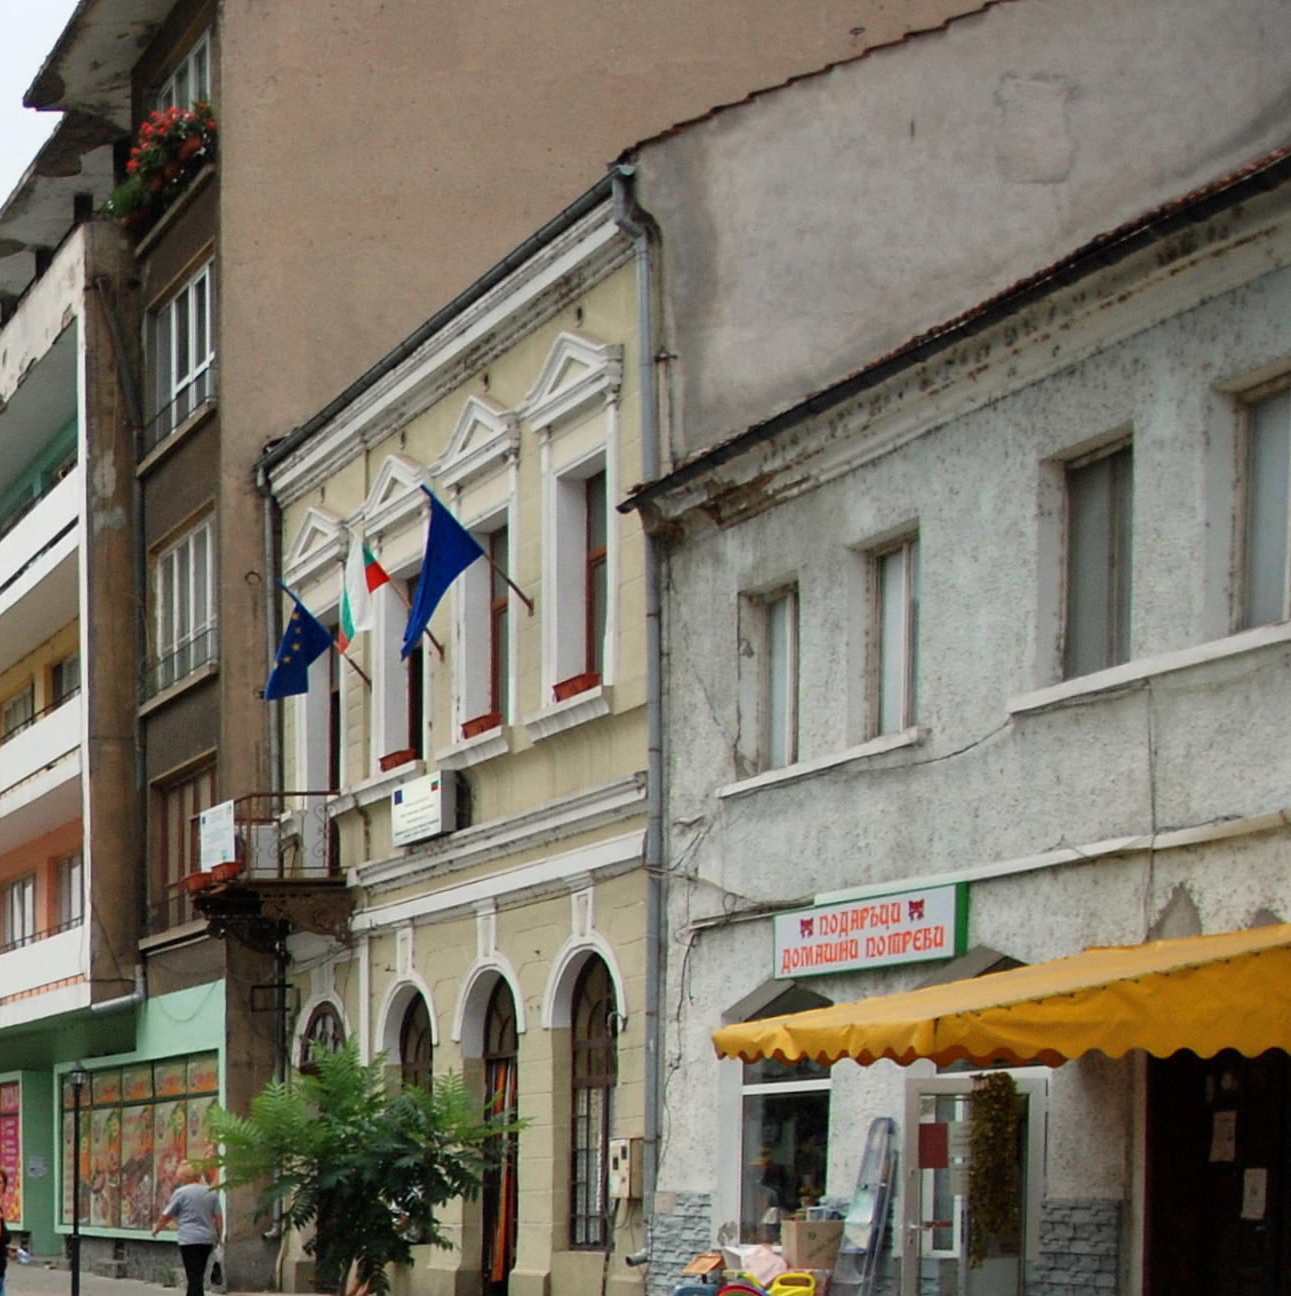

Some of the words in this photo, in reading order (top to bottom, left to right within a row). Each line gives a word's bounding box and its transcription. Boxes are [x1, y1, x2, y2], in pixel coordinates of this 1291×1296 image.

[819, 902, 902, 937] ПОДАРЪЦИ
[781, 938, 859, 974] ДОМАШНИ
[865, 925, 945, 958] ПОТРЕБИ
